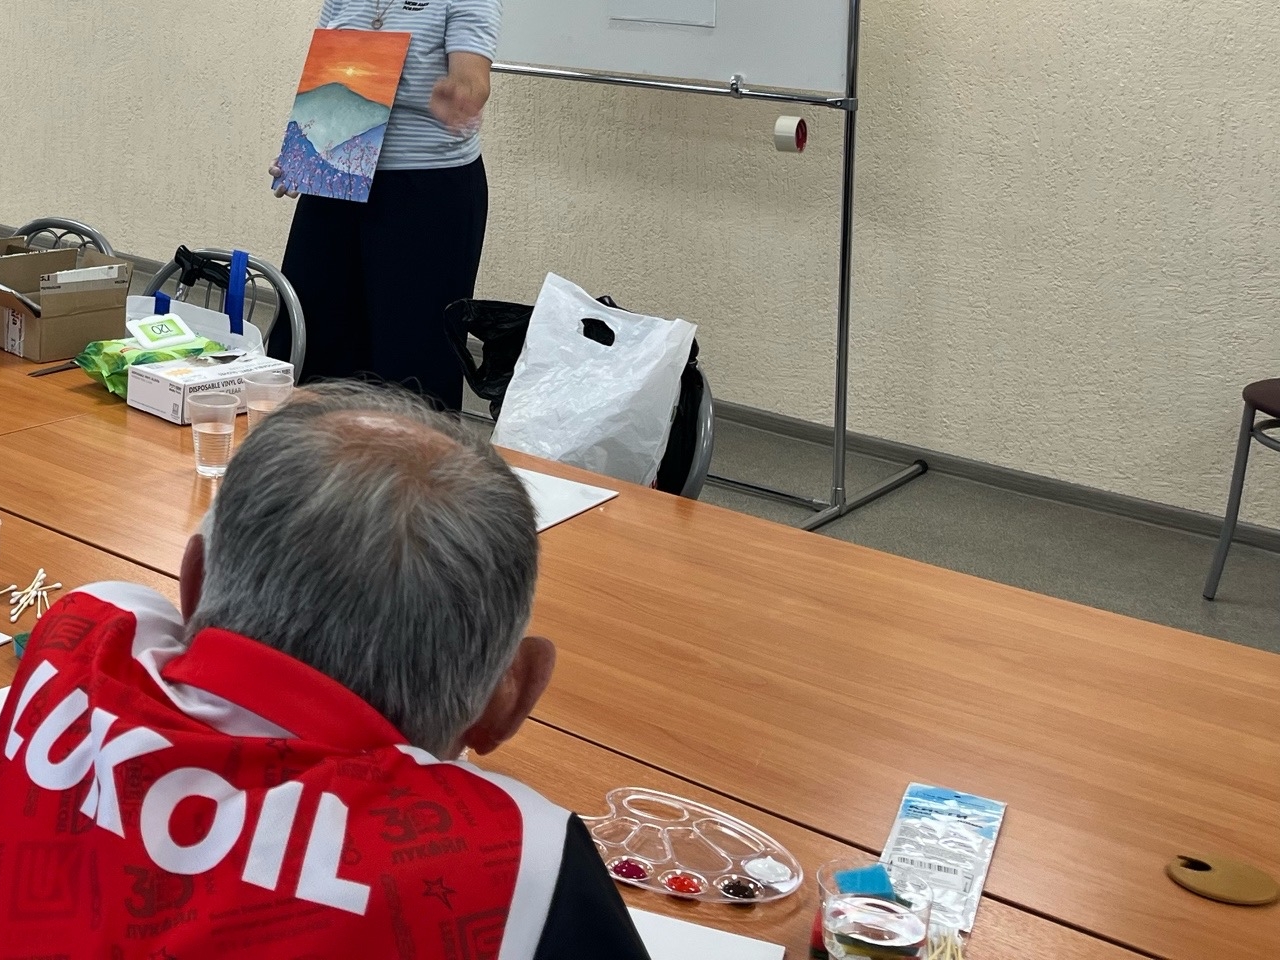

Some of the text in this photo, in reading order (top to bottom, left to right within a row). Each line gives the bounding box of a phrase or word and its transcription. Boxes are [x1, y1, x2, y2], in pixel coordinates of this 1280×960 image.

[151, 324, 173, 335] 120
[189, 382, 220, 393] DISPOSABLE
[4, 659, 371, 917] LUKOIL
